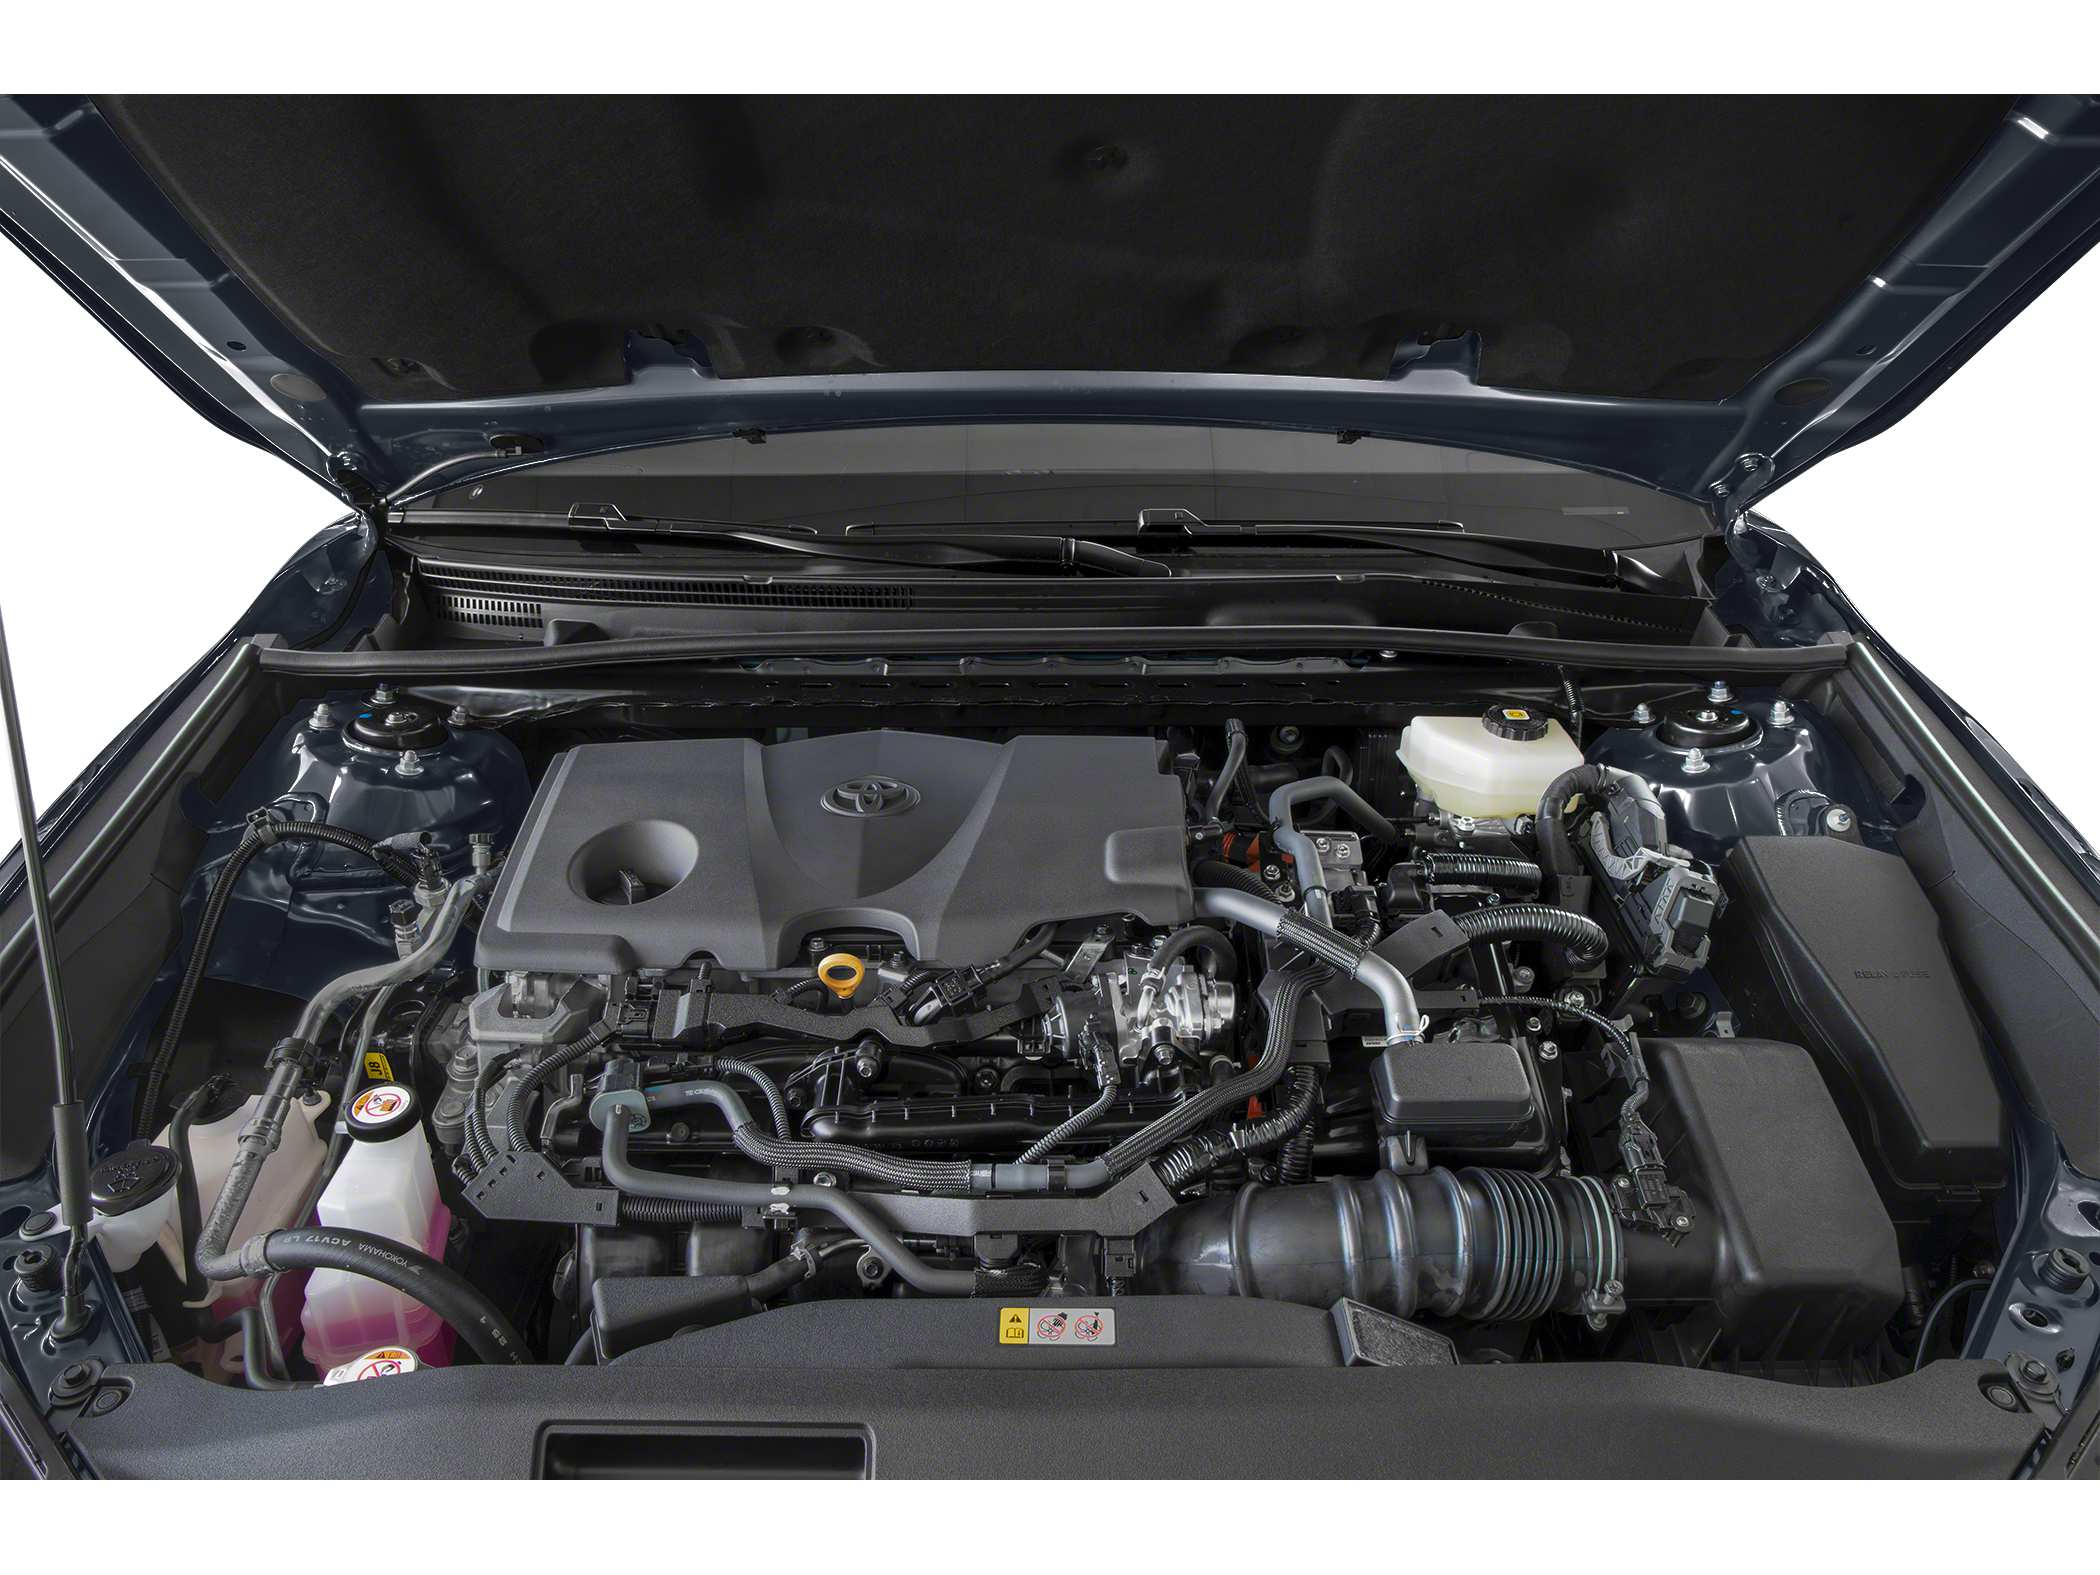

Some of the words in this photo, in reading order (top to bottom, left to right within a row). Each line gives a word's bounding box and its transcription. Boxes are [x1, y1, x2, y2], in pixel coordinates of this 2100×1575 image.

[1854, 970, 1889, 979] RELAY
[1901, 970, 1931, 979] FUSE
[369, 1062, 383, 1075] J8
[283, 1235, 304, 1244] LP
[305, 1236, 352, 1247] ACV17
[358, 1242, 408, 1267] YOKOHAMA
[491, 1328, 508, 1347] 25
